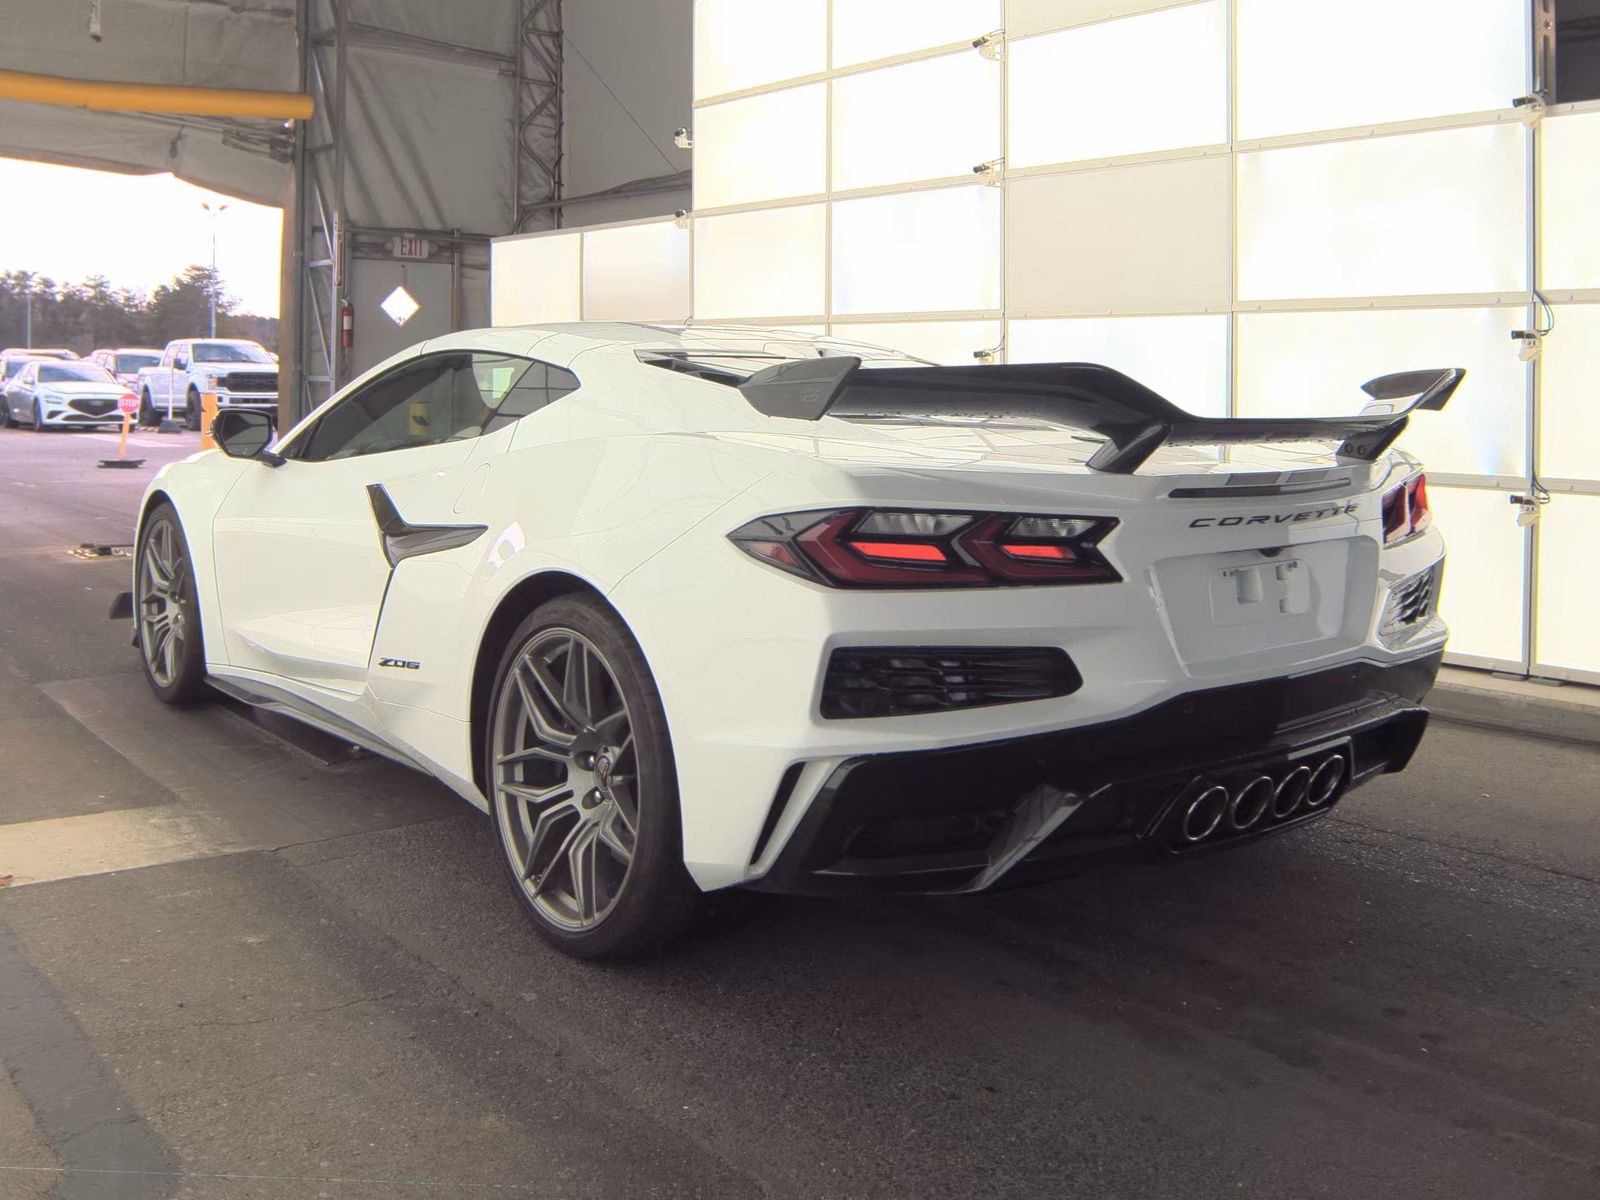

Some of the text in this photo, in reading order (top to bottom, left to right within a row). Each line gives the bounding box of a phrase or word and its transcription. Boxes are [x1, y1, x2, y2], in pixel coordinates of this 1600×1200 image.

[400, 238, 424, 257] EXIT
[119, 399, 140, 407] STOP
[1188, 504, 1359, 529] CORVETTE
[378, 657, 421, 670] Z06
